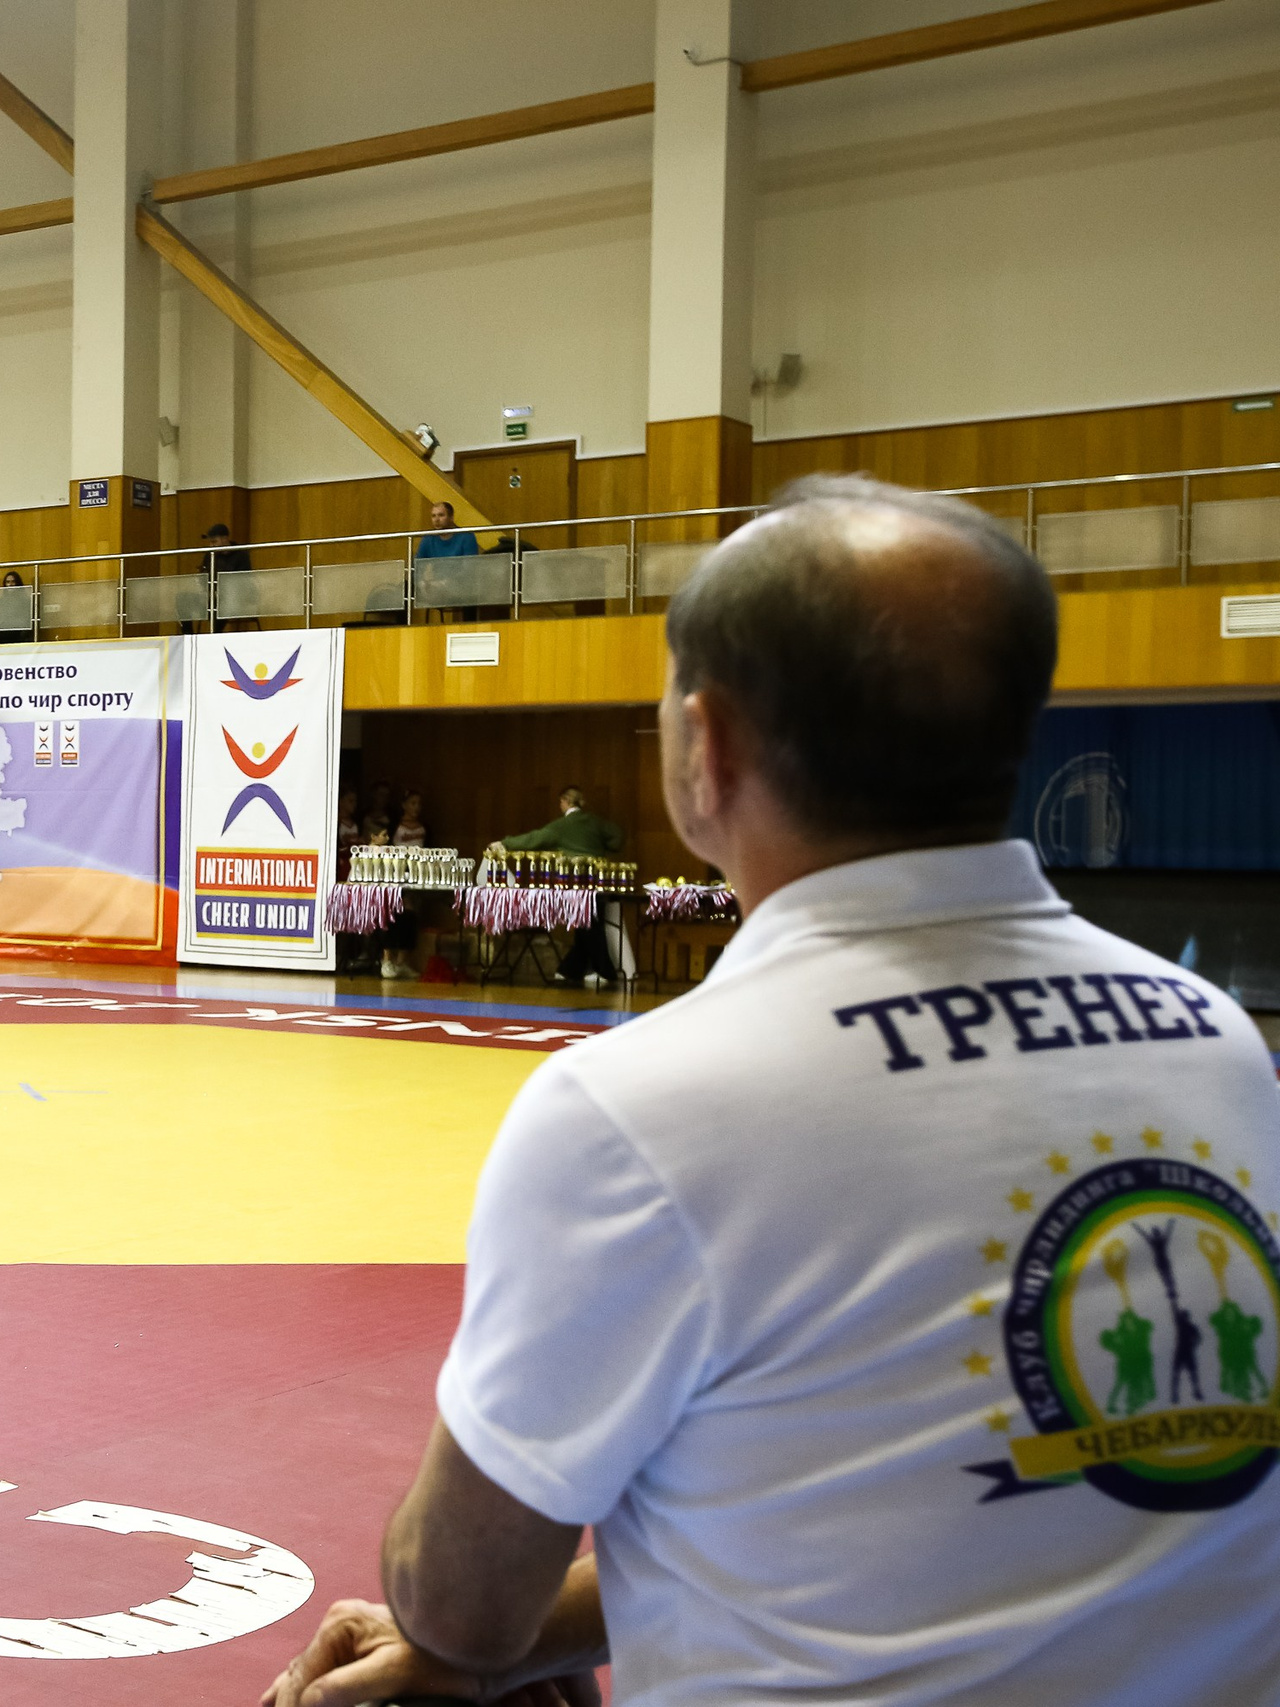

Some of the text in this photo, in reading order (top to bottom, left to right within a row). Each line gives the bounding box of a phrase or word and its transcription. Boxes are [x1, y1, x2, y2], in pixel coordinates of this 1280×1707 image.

[0, 695, 22, 710] по
[28, 693, 62, 712] чир
[67, 691, 134, 711] спорту
[199, 857, 316, 888] INTERNATIONAL
[201, 901, 310, 931] CHEER UNION
[832, 972, 1221, 1072] ТРЕНЕР
[1011, 1329, 1062, 1424] Клуб
